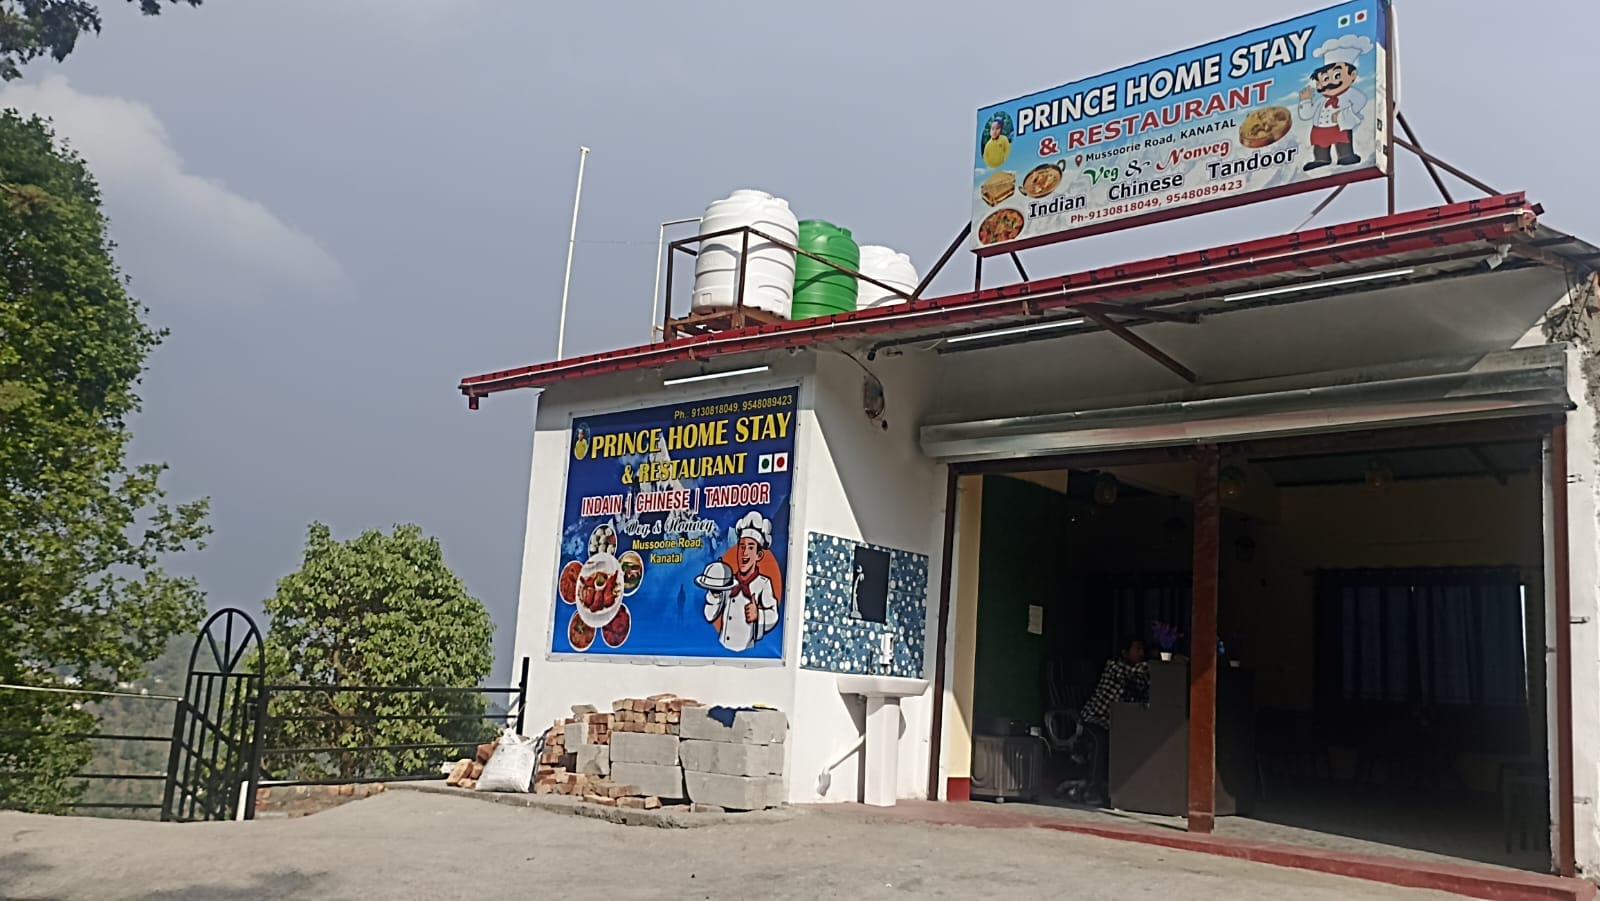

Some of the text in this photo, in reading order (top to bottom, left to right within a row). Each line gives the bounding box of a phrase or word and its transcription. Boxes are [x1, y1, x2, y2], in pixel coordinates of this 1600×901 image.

[1017, 26, 1316, 136] PRINCE HOME STAY
[1039, 80, 1273, 156] & RESTAURANT
[1086, 118, 1237, 162] Mussoorie Road, KANATAL
[1029, 148, 1297, 218] Indian Chinese Tandoor
[1083, 141, 1230, 185] Veg & Nonveg
[1070, 180, 1243, 224] Ph-9130818049, 9548089423
[691, 402, 740, 418] 9130818049,
[742, 394, 793, 411] 9548089423
[591, 411, 792, 460] PRINCE HOME STAY
[621, 452, 748, 485] & RESTAURANT
[581, 495, 623, 517] INDAIN
[636, 489, 690, 512] CHINESE
[705, 482, 771, 508] TANDOOR
[632, 539, 677, 550] Mussoorie
[652, 520, 662, 534] &
[650, 553, 683, 563] Kanatal
